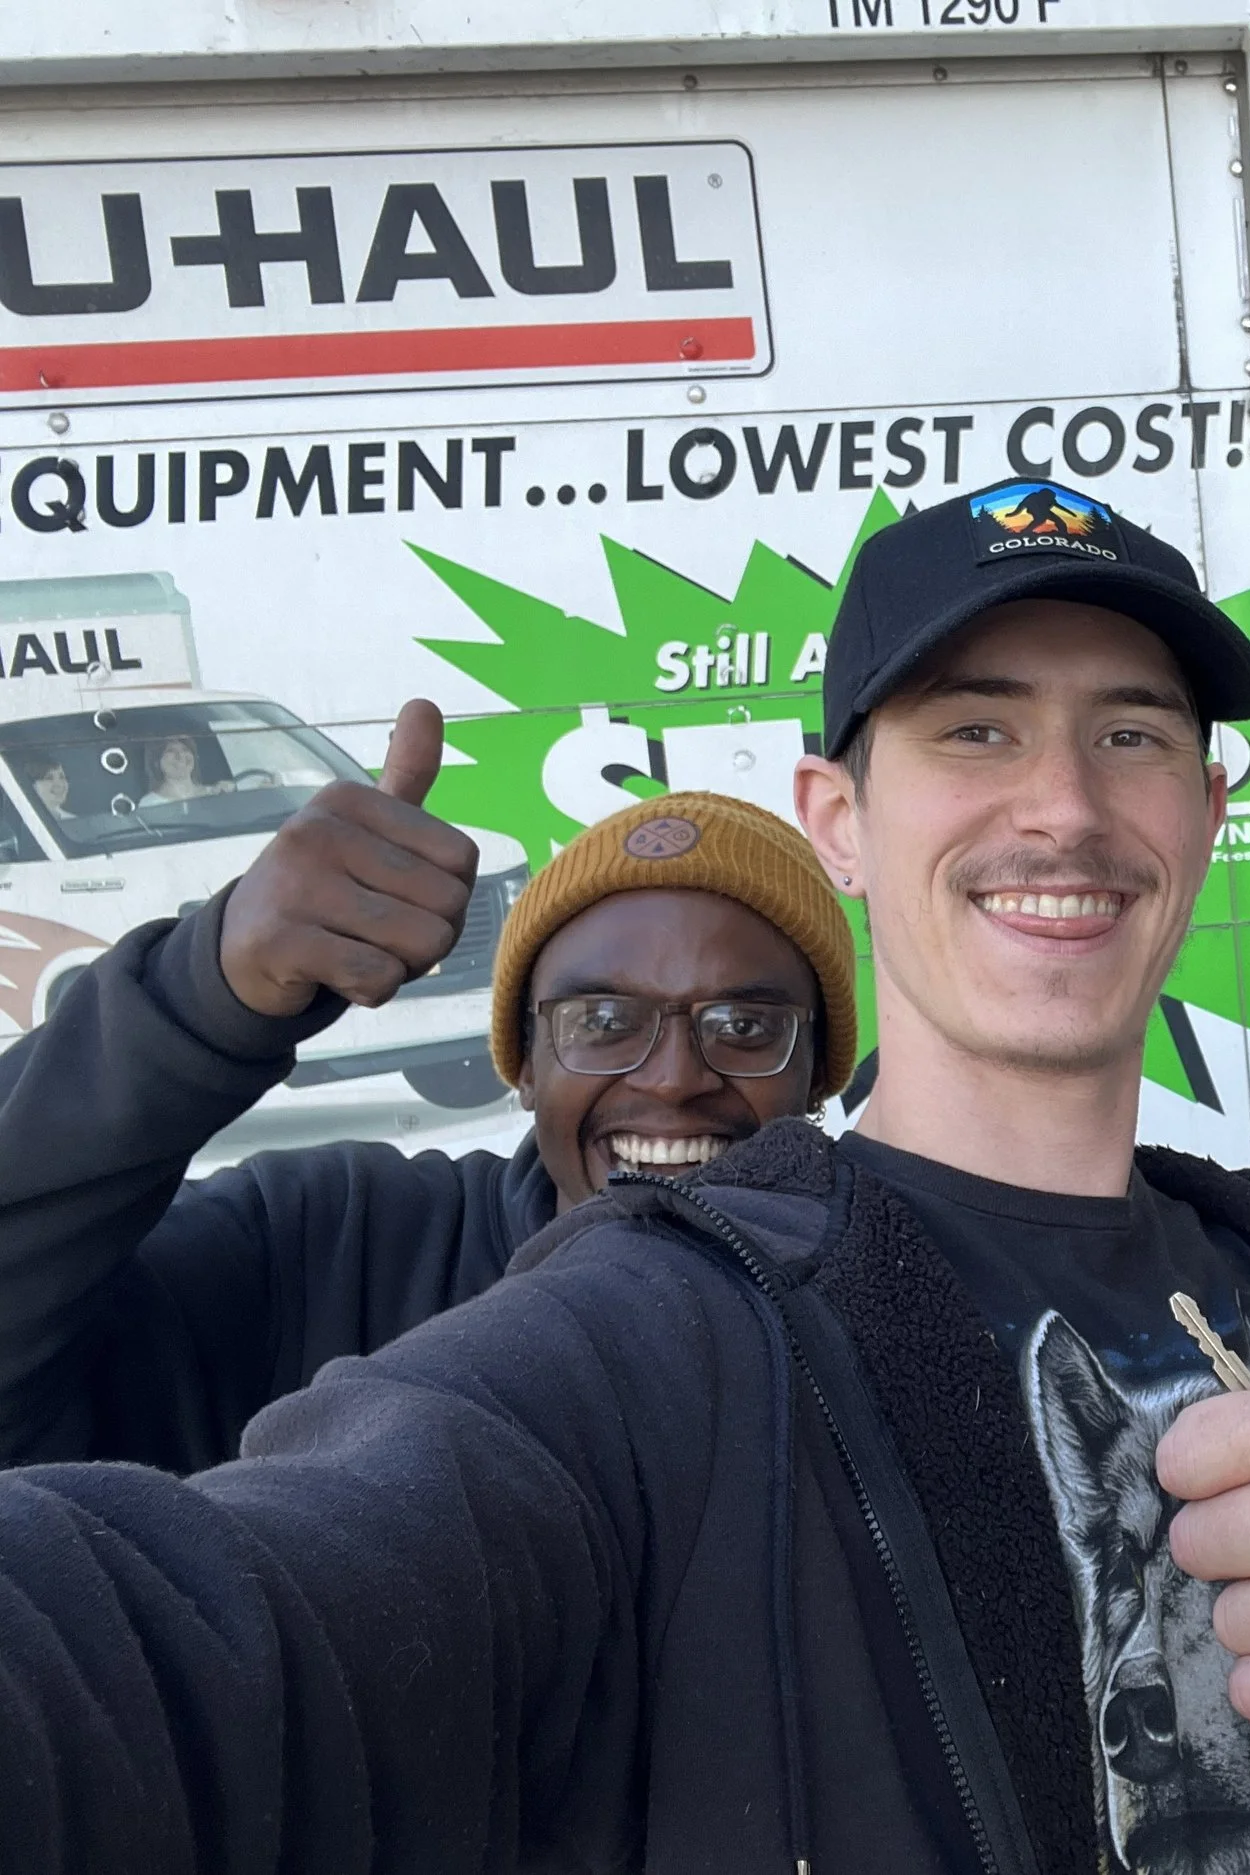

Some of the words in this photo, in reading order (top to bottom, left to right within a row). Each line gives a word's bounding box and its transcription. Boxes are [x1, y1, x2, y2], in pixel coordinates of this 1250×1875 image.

[0, 175, 734, 316] U-HAUL
[0, 437, 608, 534] QUIPMENT...
[626, 415, 975, 503] LOWEST
[1006, 399, 1246, 479] COST!
[989, 536, 1118, 561] COLORADO
[0, 628, 143, 679] AUL
[654, 632, 770, 692] Still
